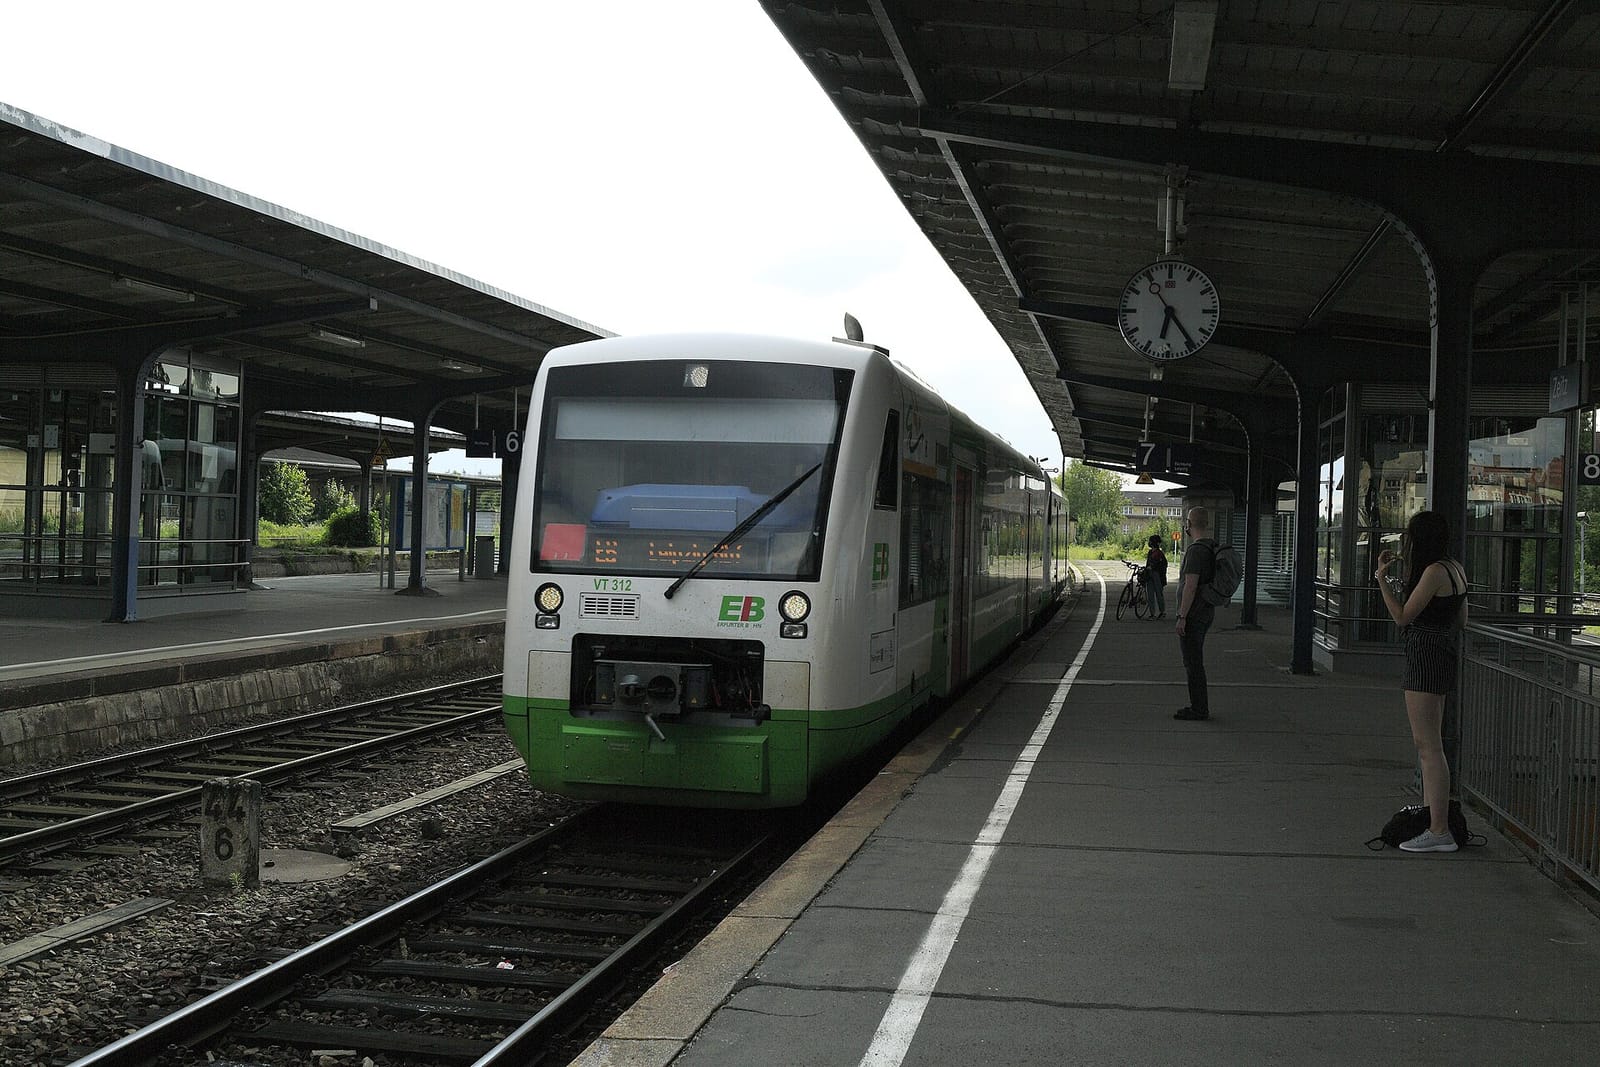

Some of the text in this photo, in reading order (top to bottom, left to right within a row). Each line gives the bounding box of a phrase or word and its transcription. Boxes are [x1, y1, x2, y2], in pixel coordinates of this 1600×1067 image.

[505, 431, 519, 453] 6
[1140, 442, 1156, 466] 7
[1583, 454, 1600, 480] 8
[872, 543, 889, 580] EB
[593, 578, 632, 592] VT 312
[719, 595, 766, 622] EB
[215, 826, 234, 861] 6
